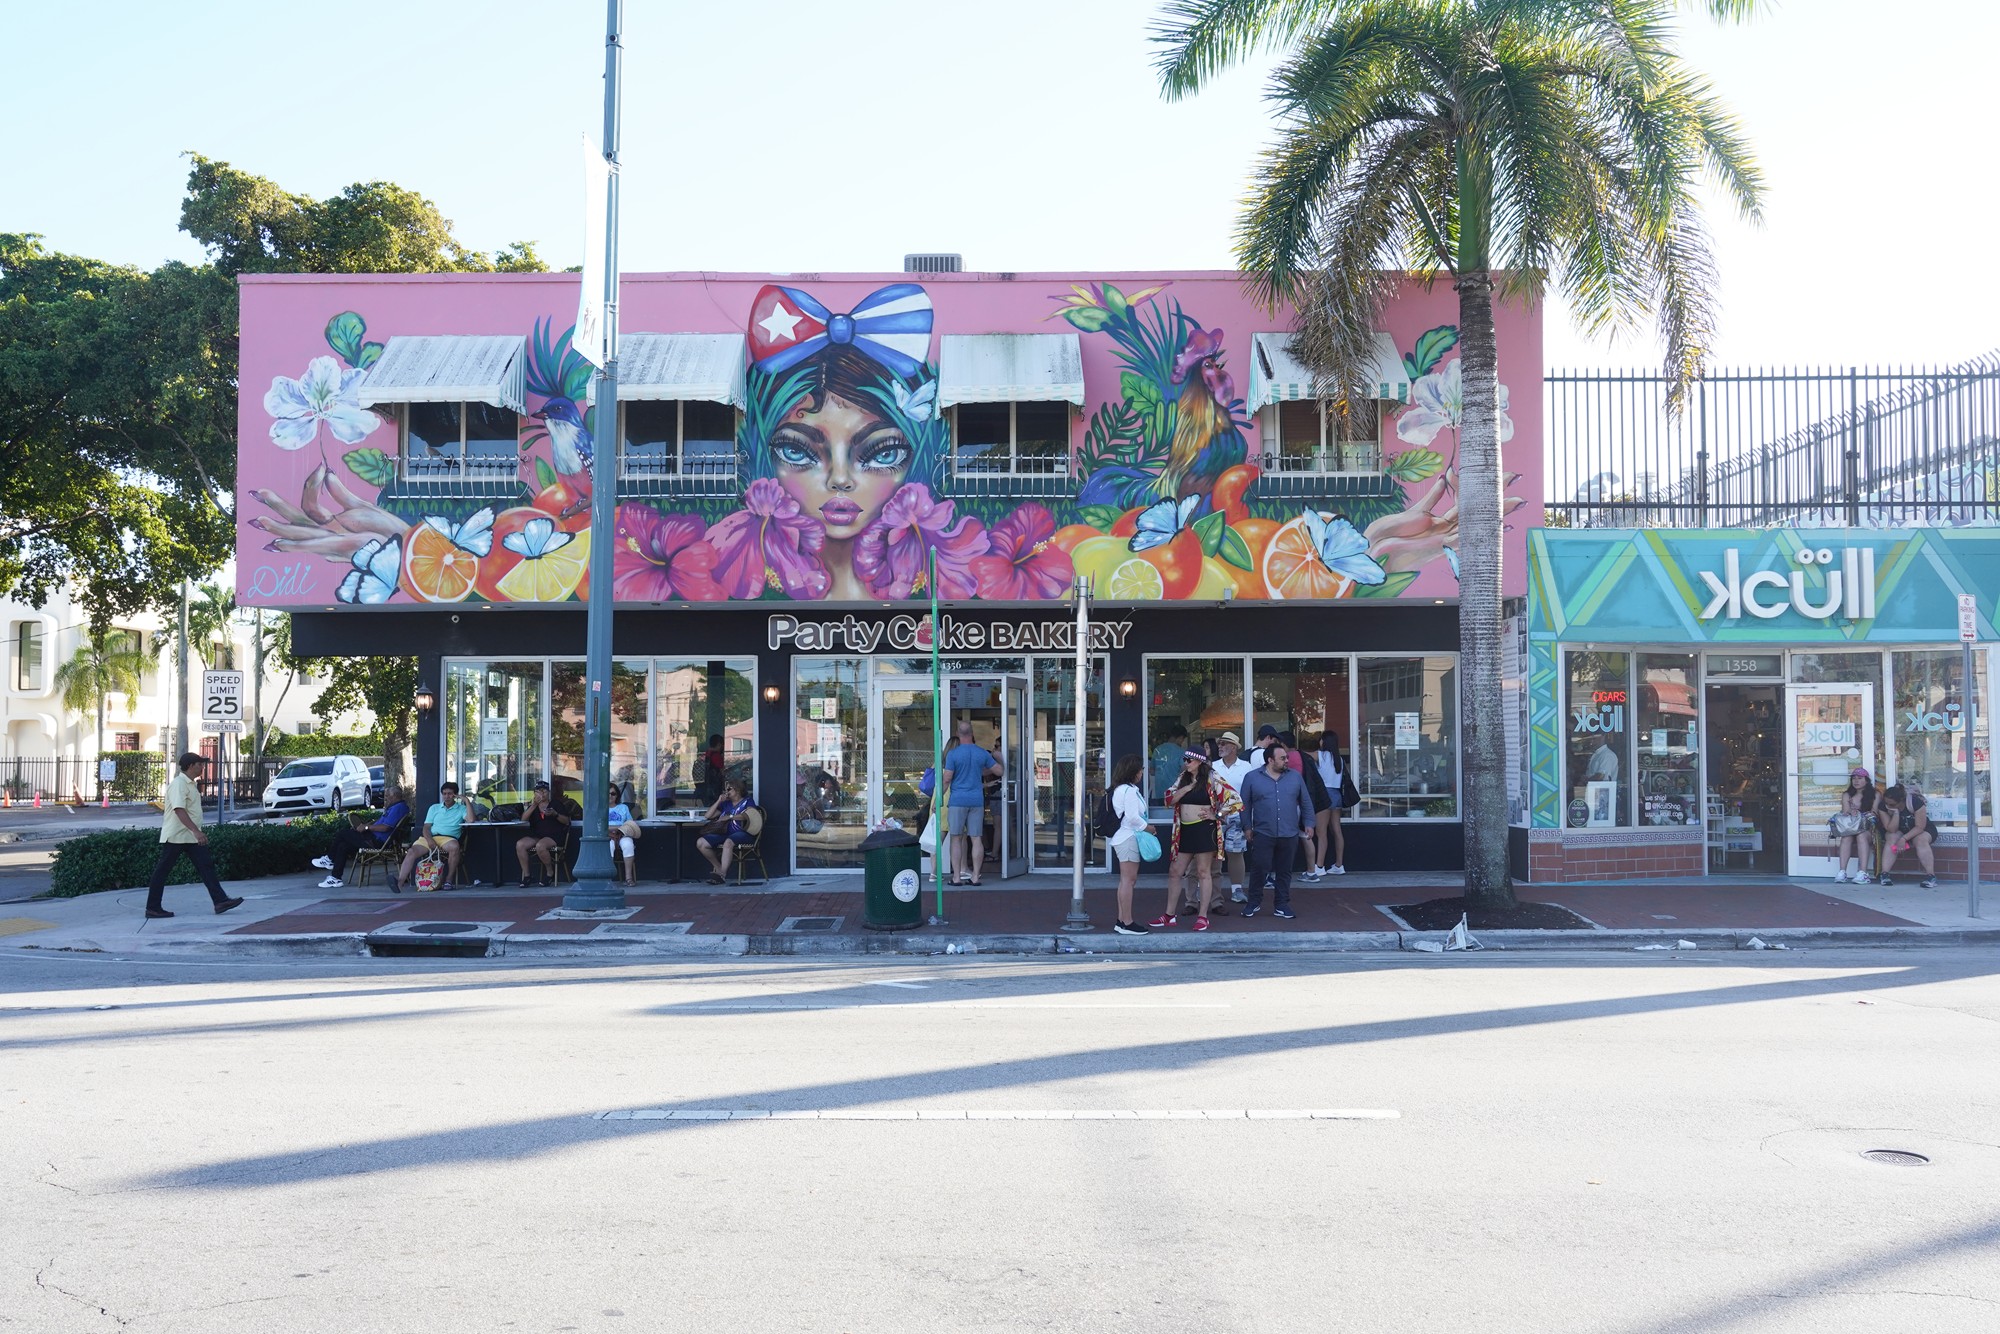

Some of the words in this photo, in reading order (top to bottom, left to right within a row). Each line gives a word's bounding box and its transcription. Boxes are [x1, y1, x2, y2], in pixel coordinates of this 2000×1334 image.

[768, 614, 885, 653] Party
[887, 614, 985, 651] Cke
[942, 660, 961, 671] 1356
[1725, 660, 1757, 672] 1358
[206, 675, 241, 684] SPEED
[210, 686, 237, 694] LIMIT
[1592, 691, 1626, 703] CIGARS
[207, 696, 238, 714] 25
[1905, 703, 1977, 732] kcül
[203, 723, 240, 731] RESIDENTIAL
